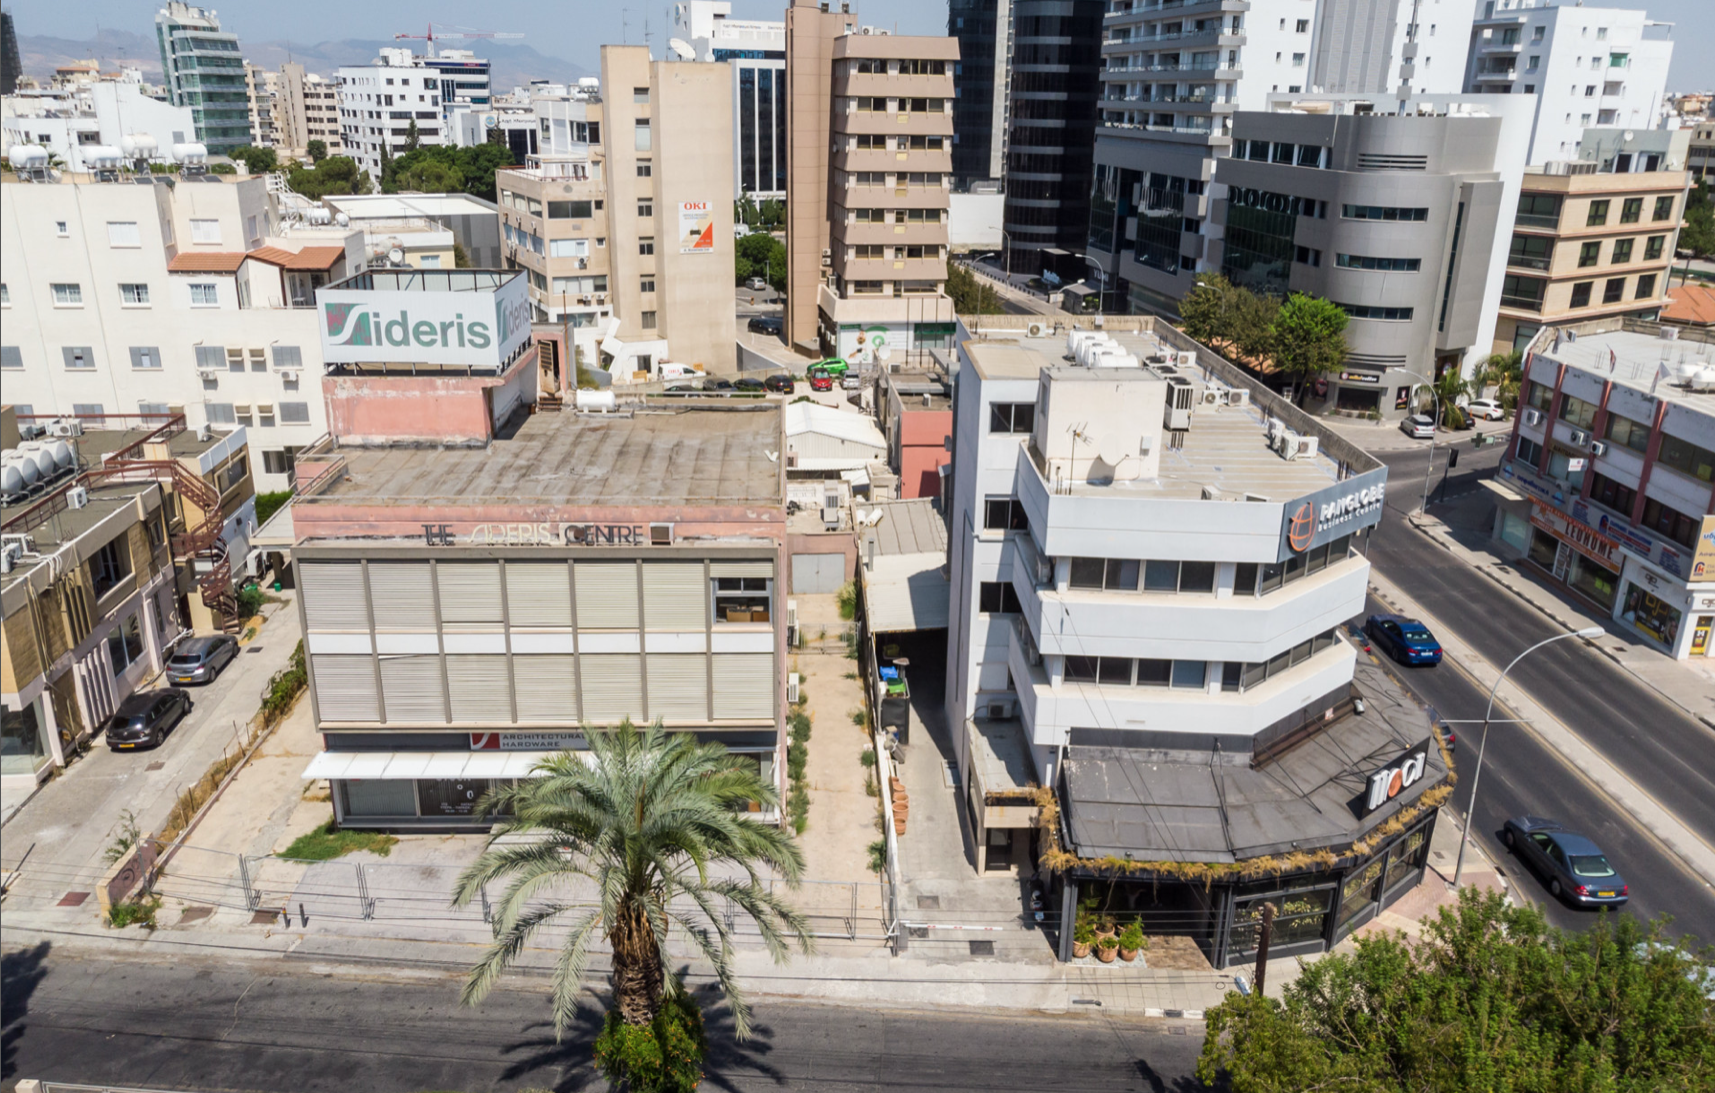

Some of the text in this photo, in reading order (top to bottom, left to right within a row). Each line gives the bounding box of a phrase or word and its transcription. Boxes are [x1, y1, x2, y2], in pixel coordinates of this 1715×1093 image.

[683, 202, 707, 211] OKI
[1320, 483, 1385, 522] PANGLOBE
[421, 524, 454, 546] THE
[564, 524, 643, 546] CENTRE
[502, 732, 587, 740] ARCHITECTURAL
